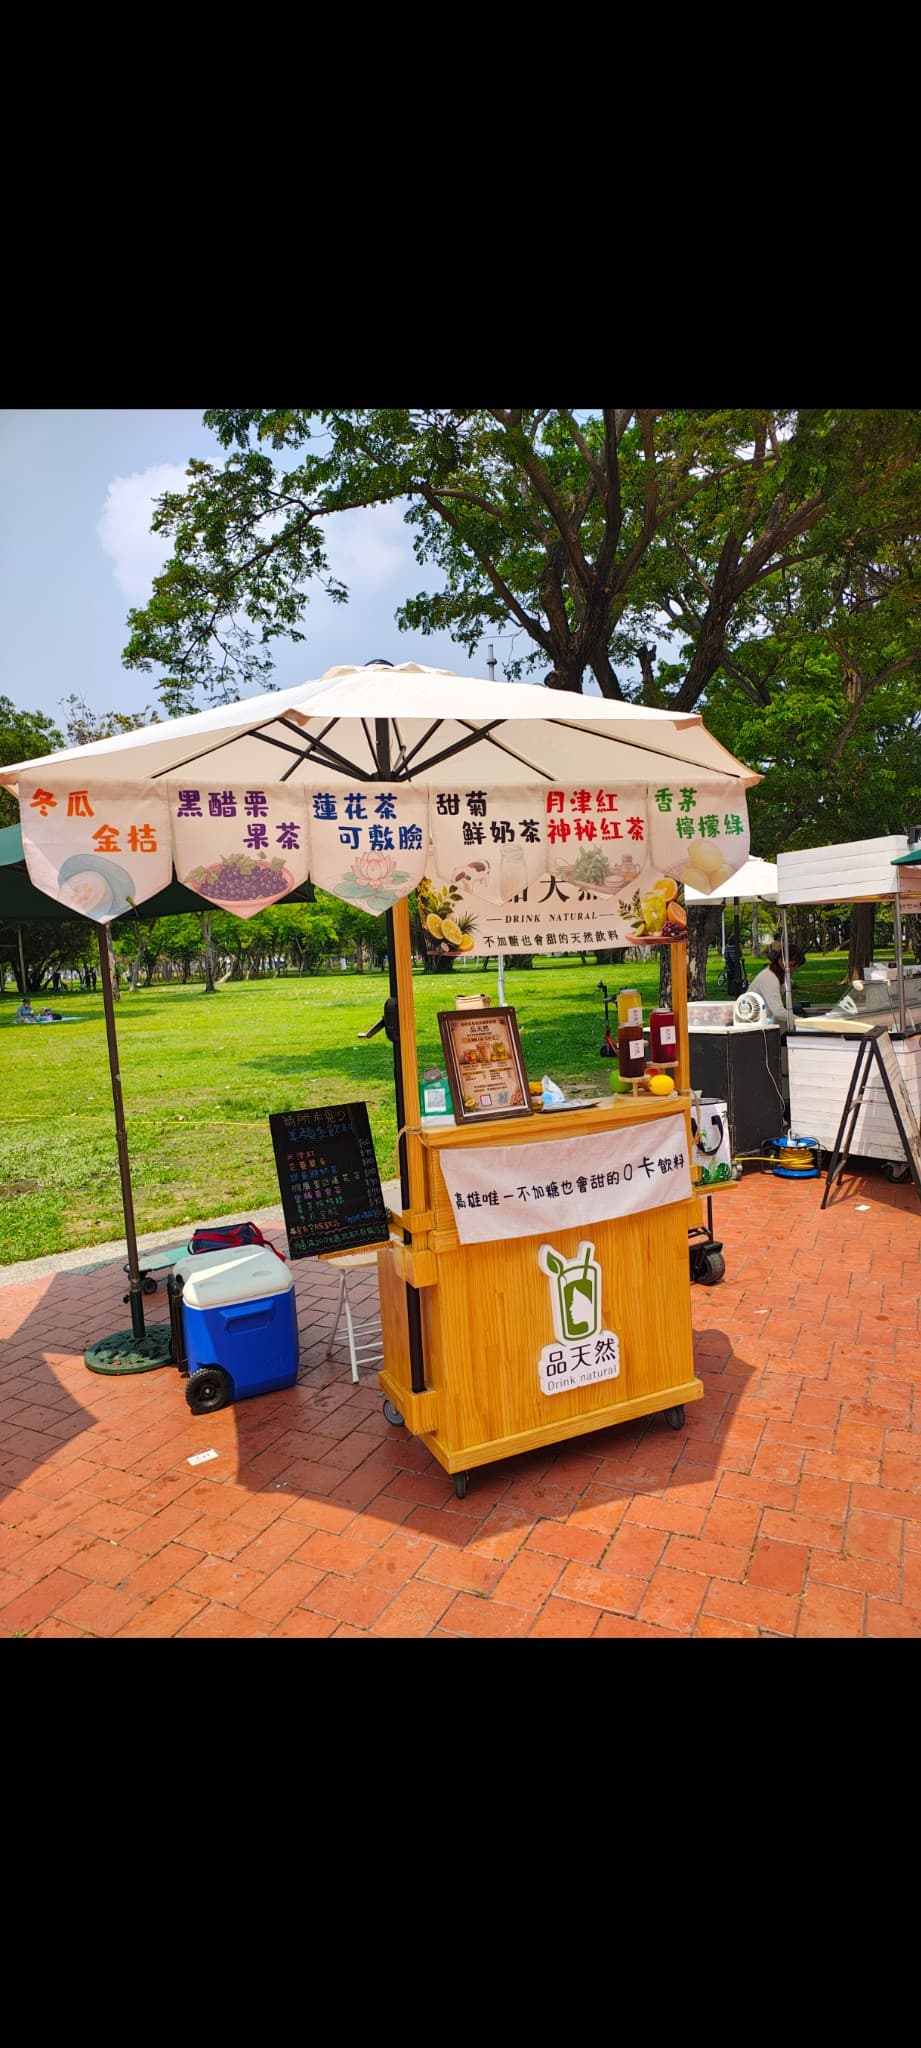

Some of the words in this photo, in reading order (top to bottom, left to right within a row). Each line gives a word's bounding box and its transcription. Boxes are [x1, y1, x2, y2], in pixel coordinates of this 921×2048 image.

[29, 788, 95, 818] 冬瓜
[177, 789, 270, 818] 黑醋栗
[312, 792, 399, 821] 蓮花茶
[436, 790, 488, 817] 甜菊
[546, 789, 619, 815] 月津紅
[654, 786, 698, 813] 香茅
[91, 823, 158, 853] 金桔
[243, 822, 301, 851] 果茶
[338, 823, 423, 852] 可敷臉
[462, 819, 542, 846] 鮮奶茶
[675, 813, 745, 840] 檸檬綠
[505, 914, 541, 924] DRINK
[549, 911, 599, 923] NATURAL
[482, 929, 619, 948] 不加糖也會甜的天然飲料
[546, 1337, 616, 1377] 品天然
[547, 1375, 576, 1391] Drink
[580, 1365, 617, 1381] natural
